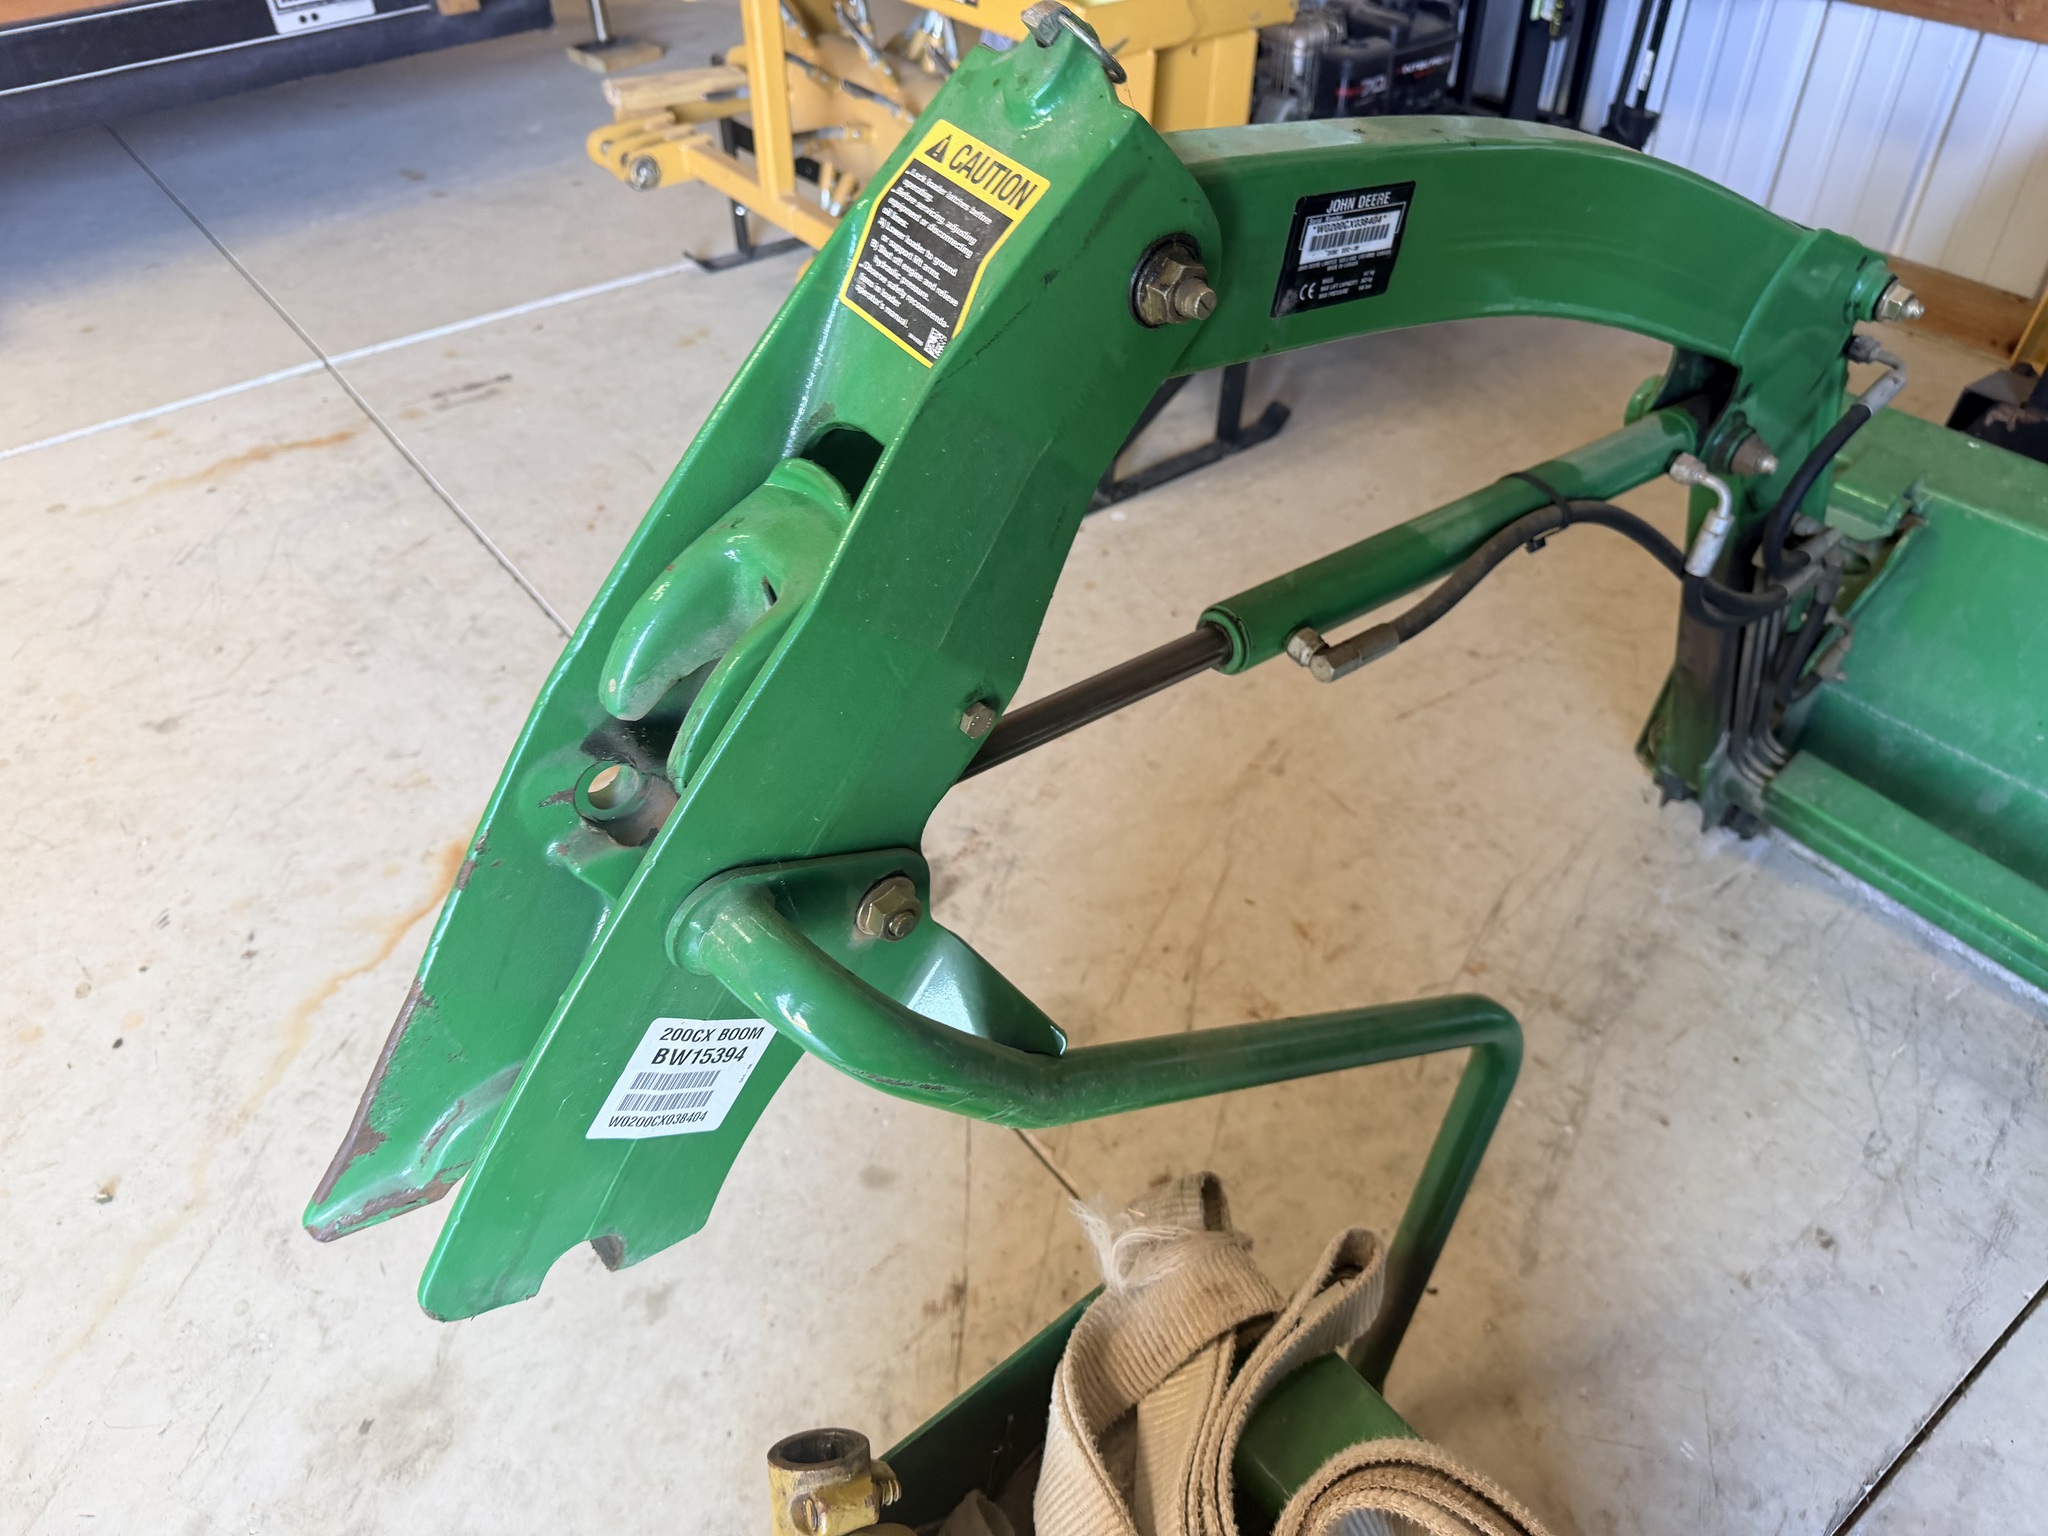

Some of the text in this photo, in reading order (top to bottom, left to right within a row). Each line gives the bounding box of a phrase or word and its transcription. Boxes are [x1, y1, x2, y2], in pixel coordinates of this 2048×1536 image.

[949, 144, 1038, 210] CAUTION
[902, 179, 934, 202] operating.
[1326, 192, 1392, 213] JOHN DEERE
[896, 186, 918, 204] Before
[945, 221, 978, 246] adjusting
[945, 192, 970, 210] latches
[969, 206, 992, 225] before
[888, 197, 974, 259] equipment or disconnecting
[881, 234, 890, 242] or
[888, 239, 914, 260] support
[885, 222, 906, 240] Lower
[904, 234, 926, 254] loader
[924, 250, 934, 260] to
[932, 256, 958, 276] ground
[873, 254, 901, 280] hydraulic
[886, 280, 907, 299] safety
[901, 264, 924, 282] engine
[922, 278, 938, 292] and
[936, 288, 959, 306] relieve
[1300, 282, 1316, 300] CE
[659, 1026, 766, 1043] 200CX BOOM
[650, 1046, 749, 1066] BW15394
[608, 1110, 709, 1128] W0200CX038404
